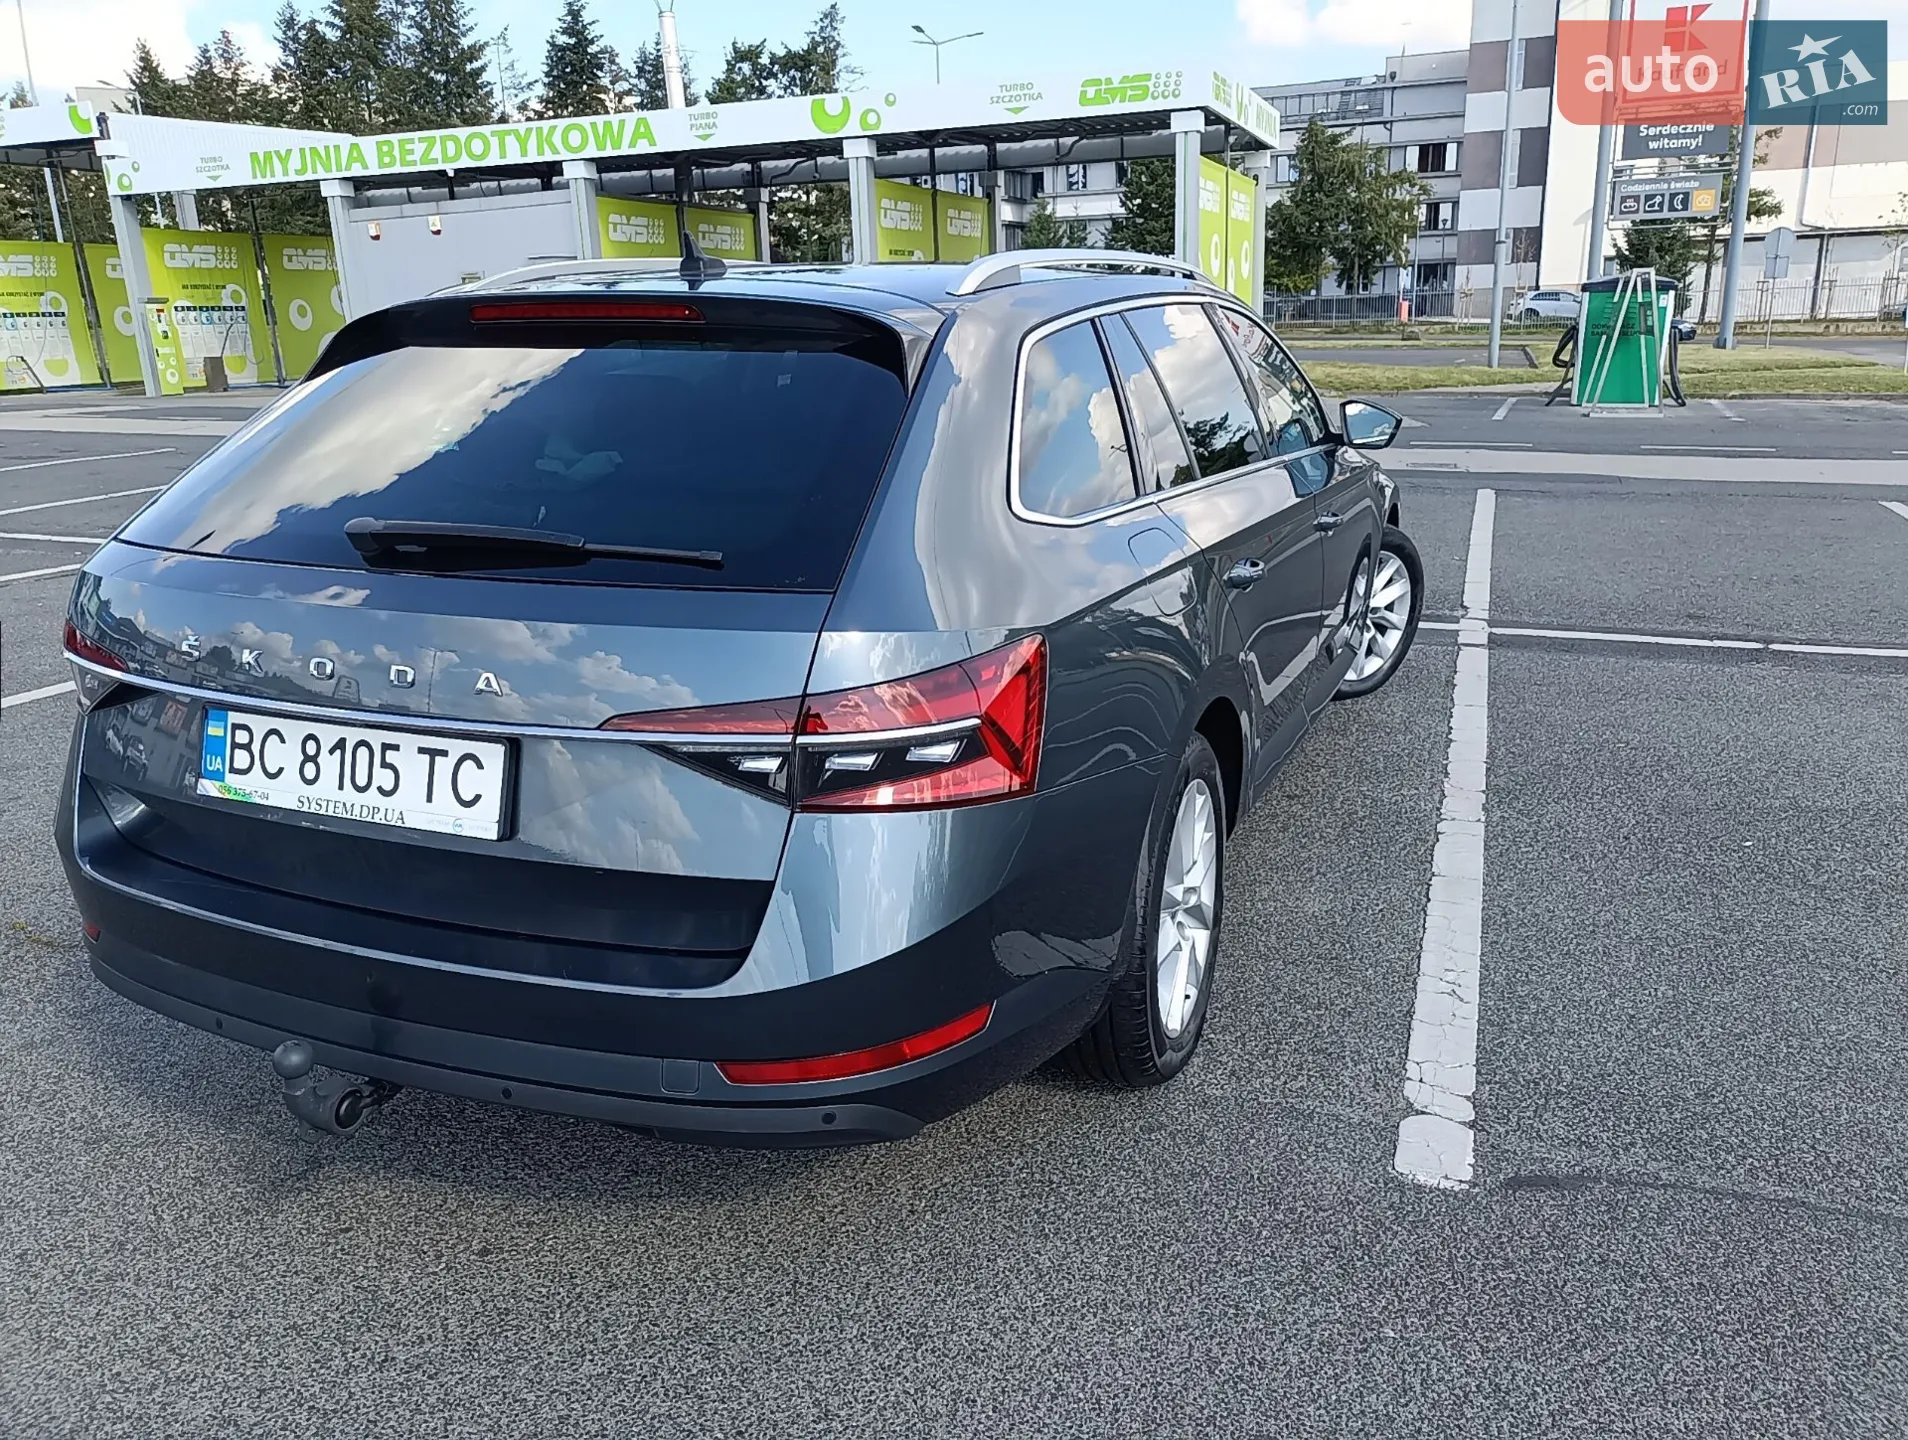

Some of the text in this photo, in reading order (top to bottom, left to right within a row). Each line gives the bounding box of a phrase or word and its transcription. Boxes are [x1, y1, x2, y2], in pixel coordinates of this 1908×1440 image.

[999, 82, 1034, 92] TURBO
[989, 91, 1043, 104] SZCZOTKA
[688, 111, 719, 121] TURBO
[689, 120, 718, 131] PIANA
[1639, 120, 1715, 137] Serdecznie
[249, 117, 658, 180] MYJNIA BEZDOTYKOWA
[1649, 135, 1703, 150] witamy!
[1620, 182, 1668, 192] Codziennie
[181, 635, 504, 697] ŠKODA
[206, 754, 224, 773] UA
[228, 722, 485, 809] BC 8105 TC
[297, 794, 406, 826] SYSTEM.DP.UA
